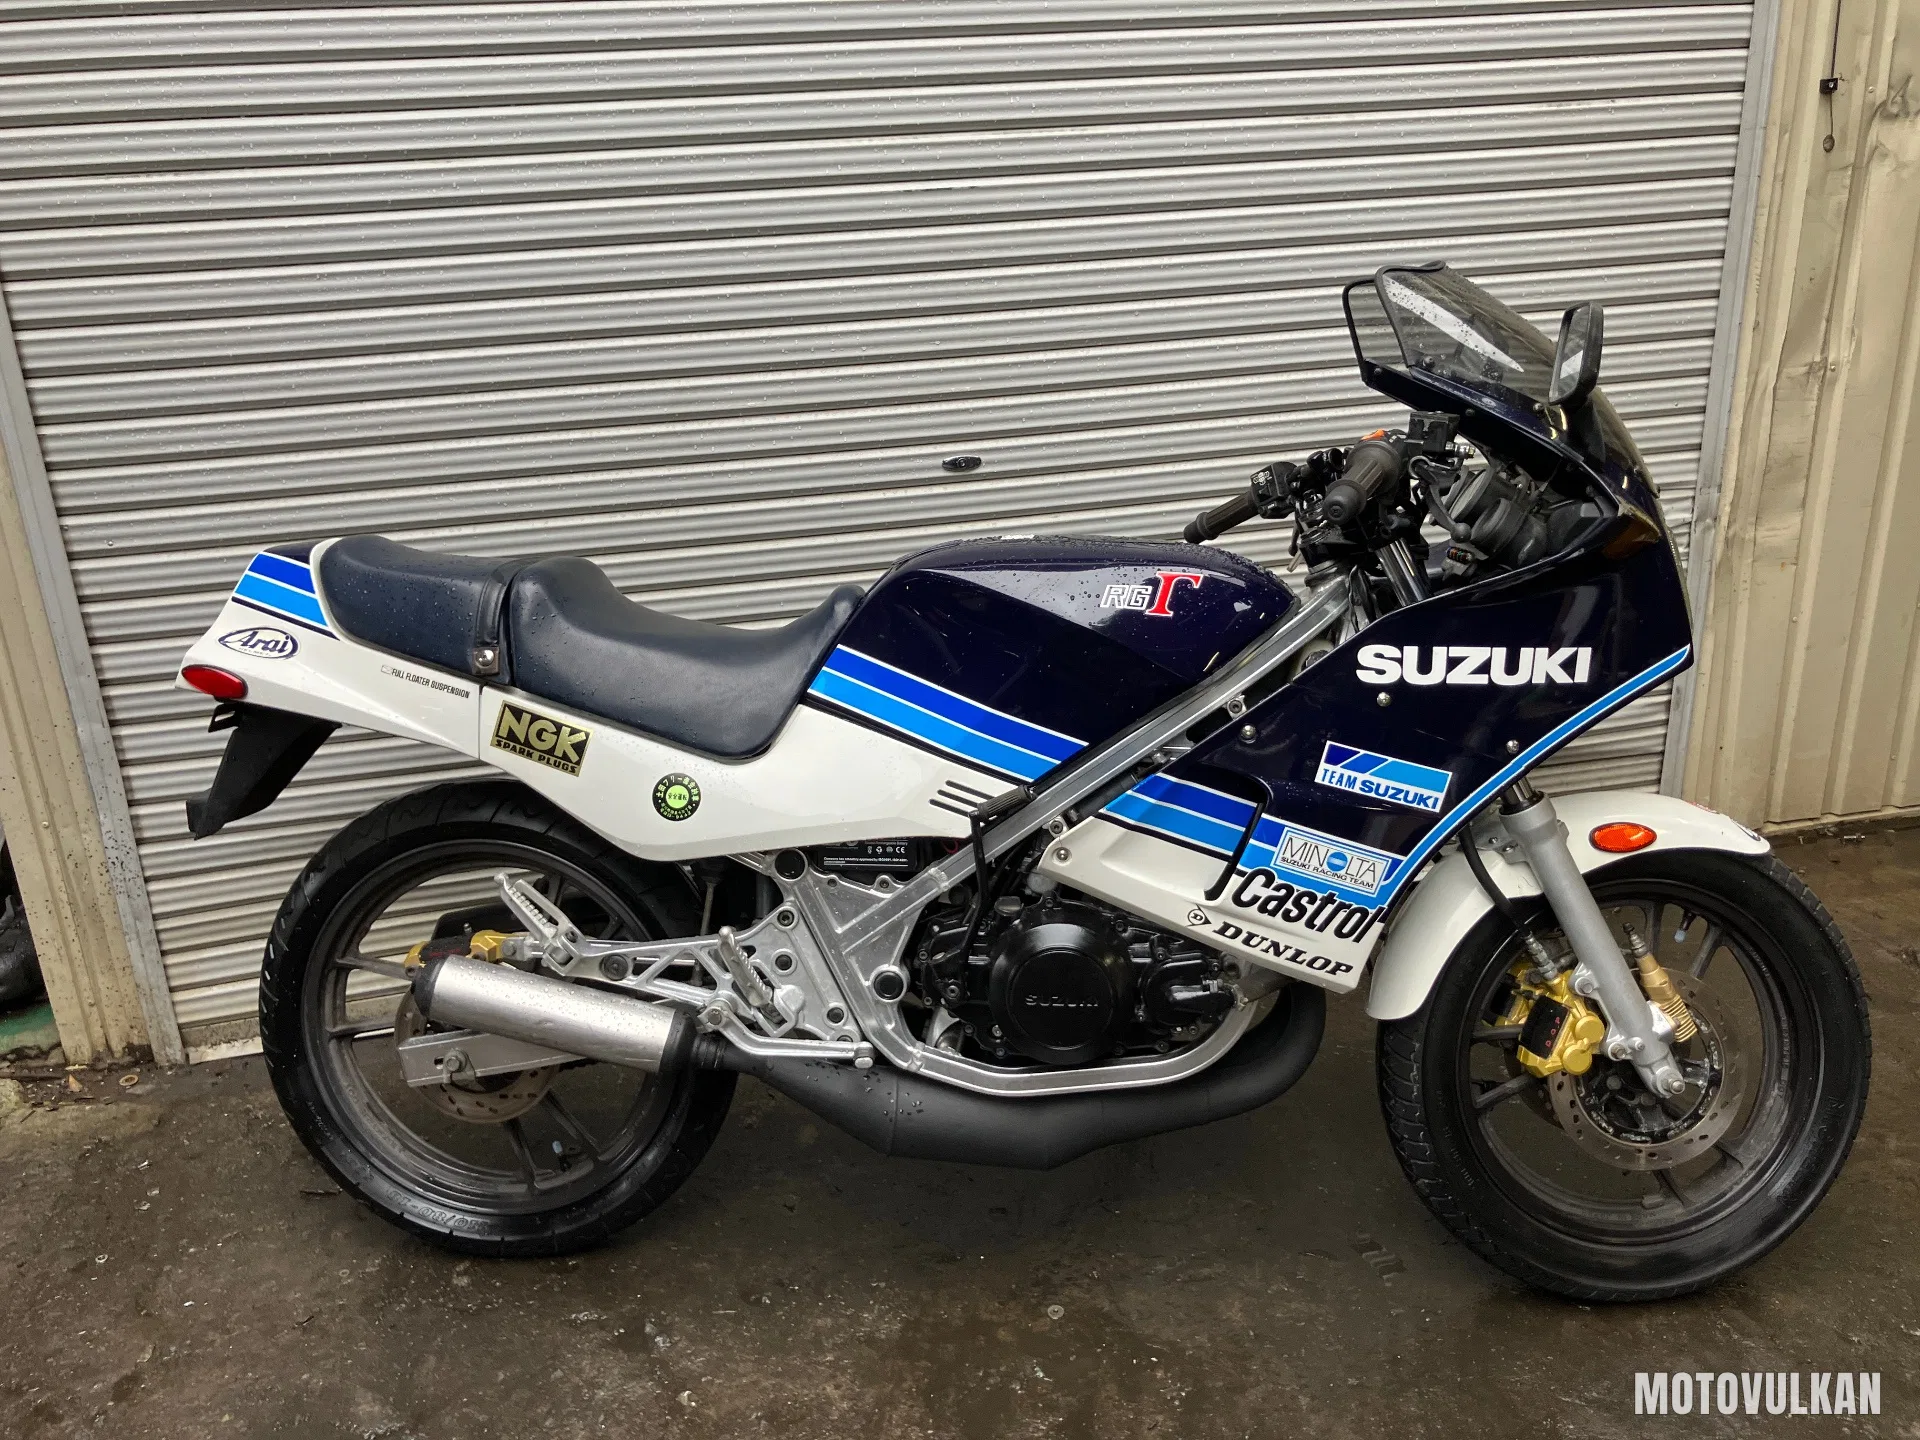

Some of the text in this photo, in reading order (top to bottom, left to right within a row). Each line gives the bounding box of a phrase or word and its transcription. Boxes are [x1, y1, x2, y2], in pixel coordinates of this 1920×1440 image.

[238, 630, 290, 654] Arai
[391, 668, 471, 699] FULL FLOATER SUSPENSION
[1356, 644, 1592, 685] SUZUKI
[498, 706, 587, 763] NGK
[495, 739, 578, 774] SPARK PLUGS
[1321, 768, 1440, 809] TEAM SUZUKI
[1280, 856, 1375, 889] SUZUKI RACING TEAM
[1282, 837, 1376, 883] MINOLTA
[1231, 867, 1387, 944] Castrol
[1212, 920, 1354, 976] DUNLOP
